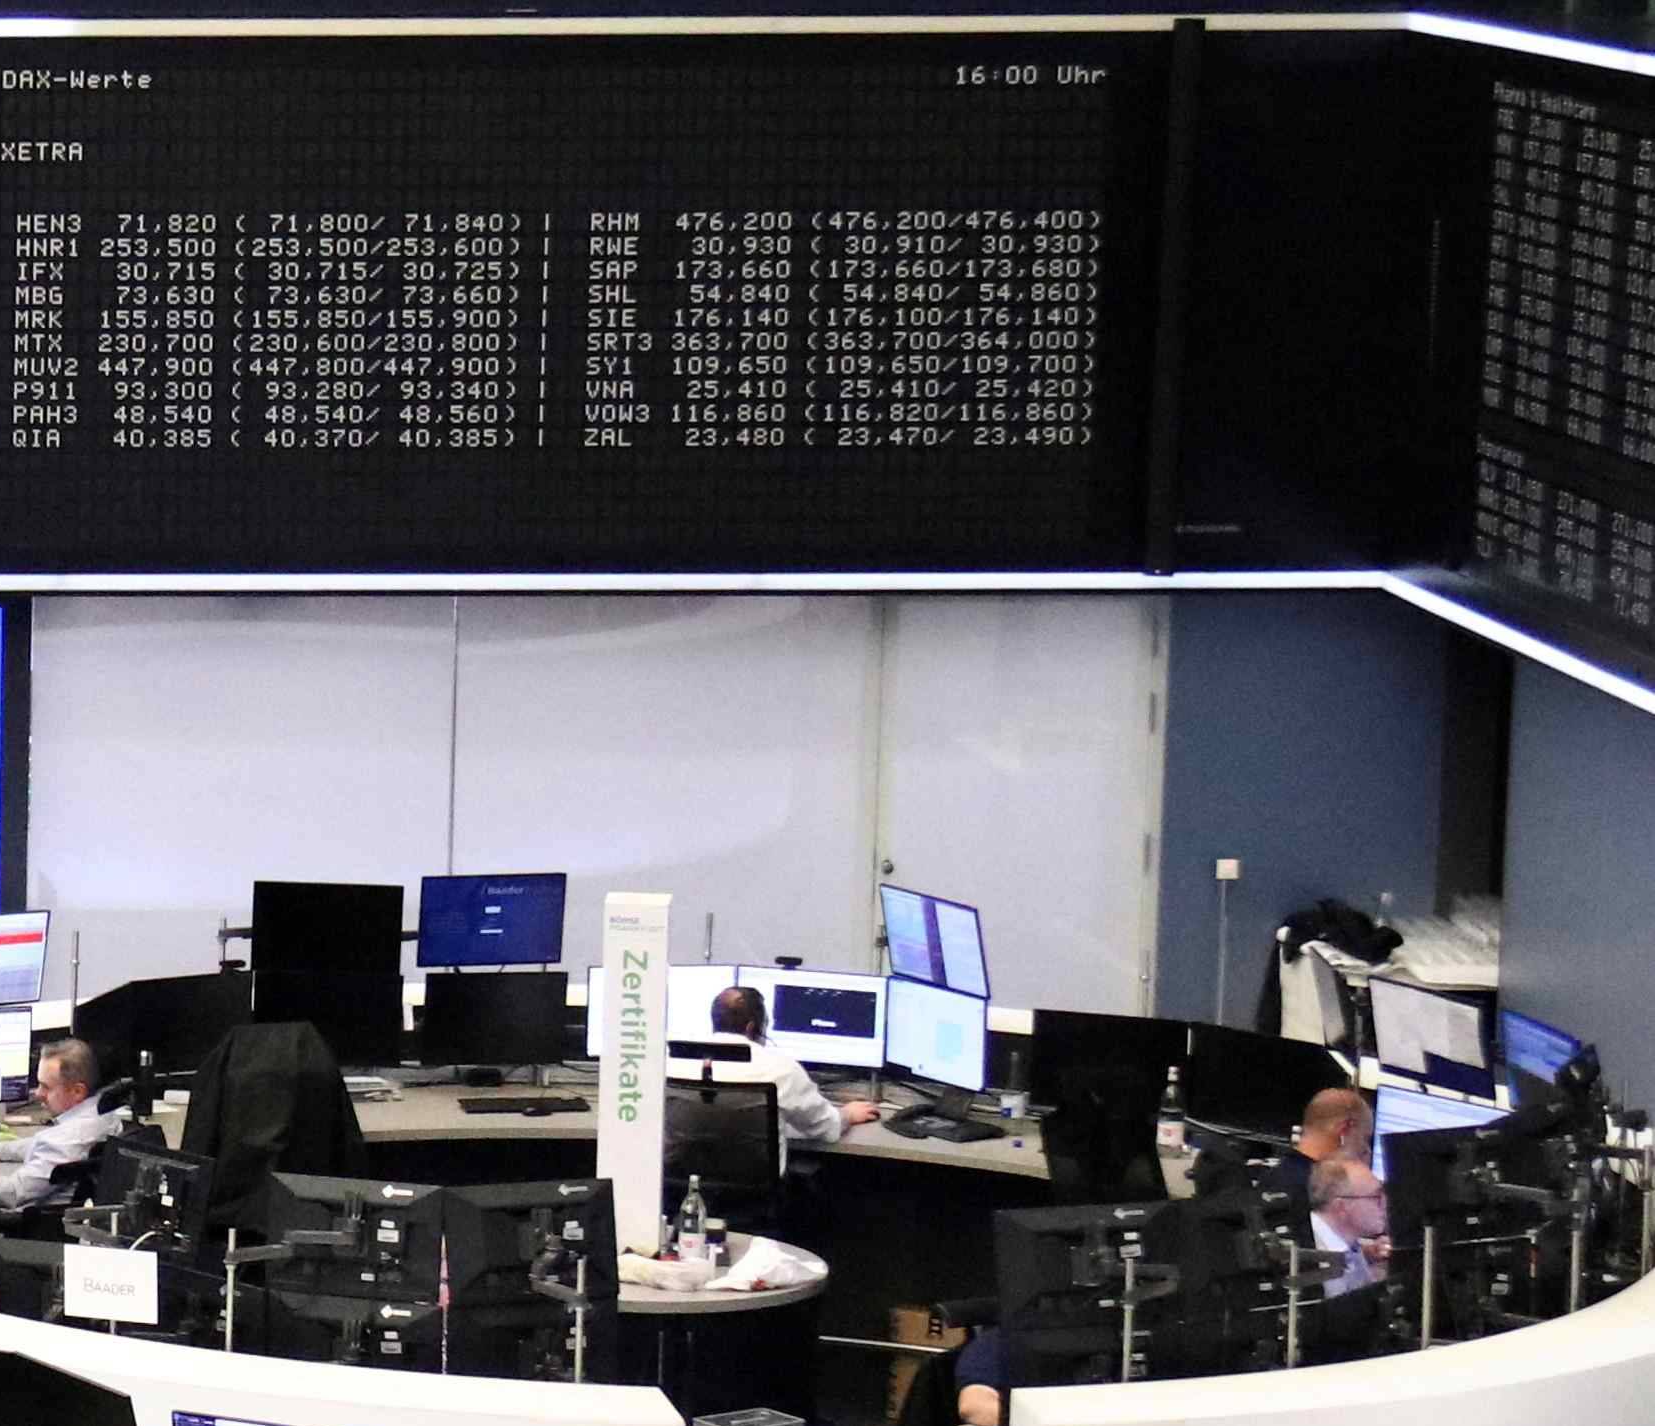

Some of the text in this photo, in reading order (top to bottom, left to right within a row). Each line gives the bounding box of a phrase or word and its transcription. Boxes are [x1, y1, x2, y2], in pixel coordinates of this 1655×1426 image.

[2, 69, 152, 90] DAX-Werte
[956, 65, 1105, 85] 16:00 Uhr
[1, 141, 83, 162] XETRA
[16, 213, 217, 234] HEN3 71,820
[590, 212, 640, 231] RHM
[675, 211, 792, 231] 476,200
[16, 237, 78, 258] HNR1
[100, 237, 216, 258] 253,500
[590, 235, 791, 256] RWE 30,930
[18, 261, 215, 281] IFX 30,715
[589, 260, 638, 280] SAP
[676, 259, 791, 279] 173,660
[15, 285, 215, 305] MBG 73,630
[588, 284, 790, 304] SHL 54,840
[14, 309, 63, 329] MRK
[101, 309, 214, 329] 155,850
[588, 308, 636, 328] SIE
[675, 307, 789, 327] 176,140
[14, 333, 63, 353] MTX
[98, 333, 214, 353] 230,700
[587, 332, 652, 351] SRT3
[671, 331, 788, 351] 363,700
[13, 357, 79, 377] MUV2
[97, 357, 213, 377] 447,900
[586, 356, 632, 376] SY1
[673, 355, 787, 375] 109,650
[13, 381, 213, 401] P911 93,300
[585, 379, 787, 399] VNA 25,410
[13, 404, 212, 424] PAH3 48,540
[585, 404, 650, 423] VOW3
[672, 403, 786, 423] 116,860
[12, 428, 212, 448] QIA 40,385
[584, 427, 785, 447] ZAL 23,480
[618, 950, 649, 1123] Zertifikate
